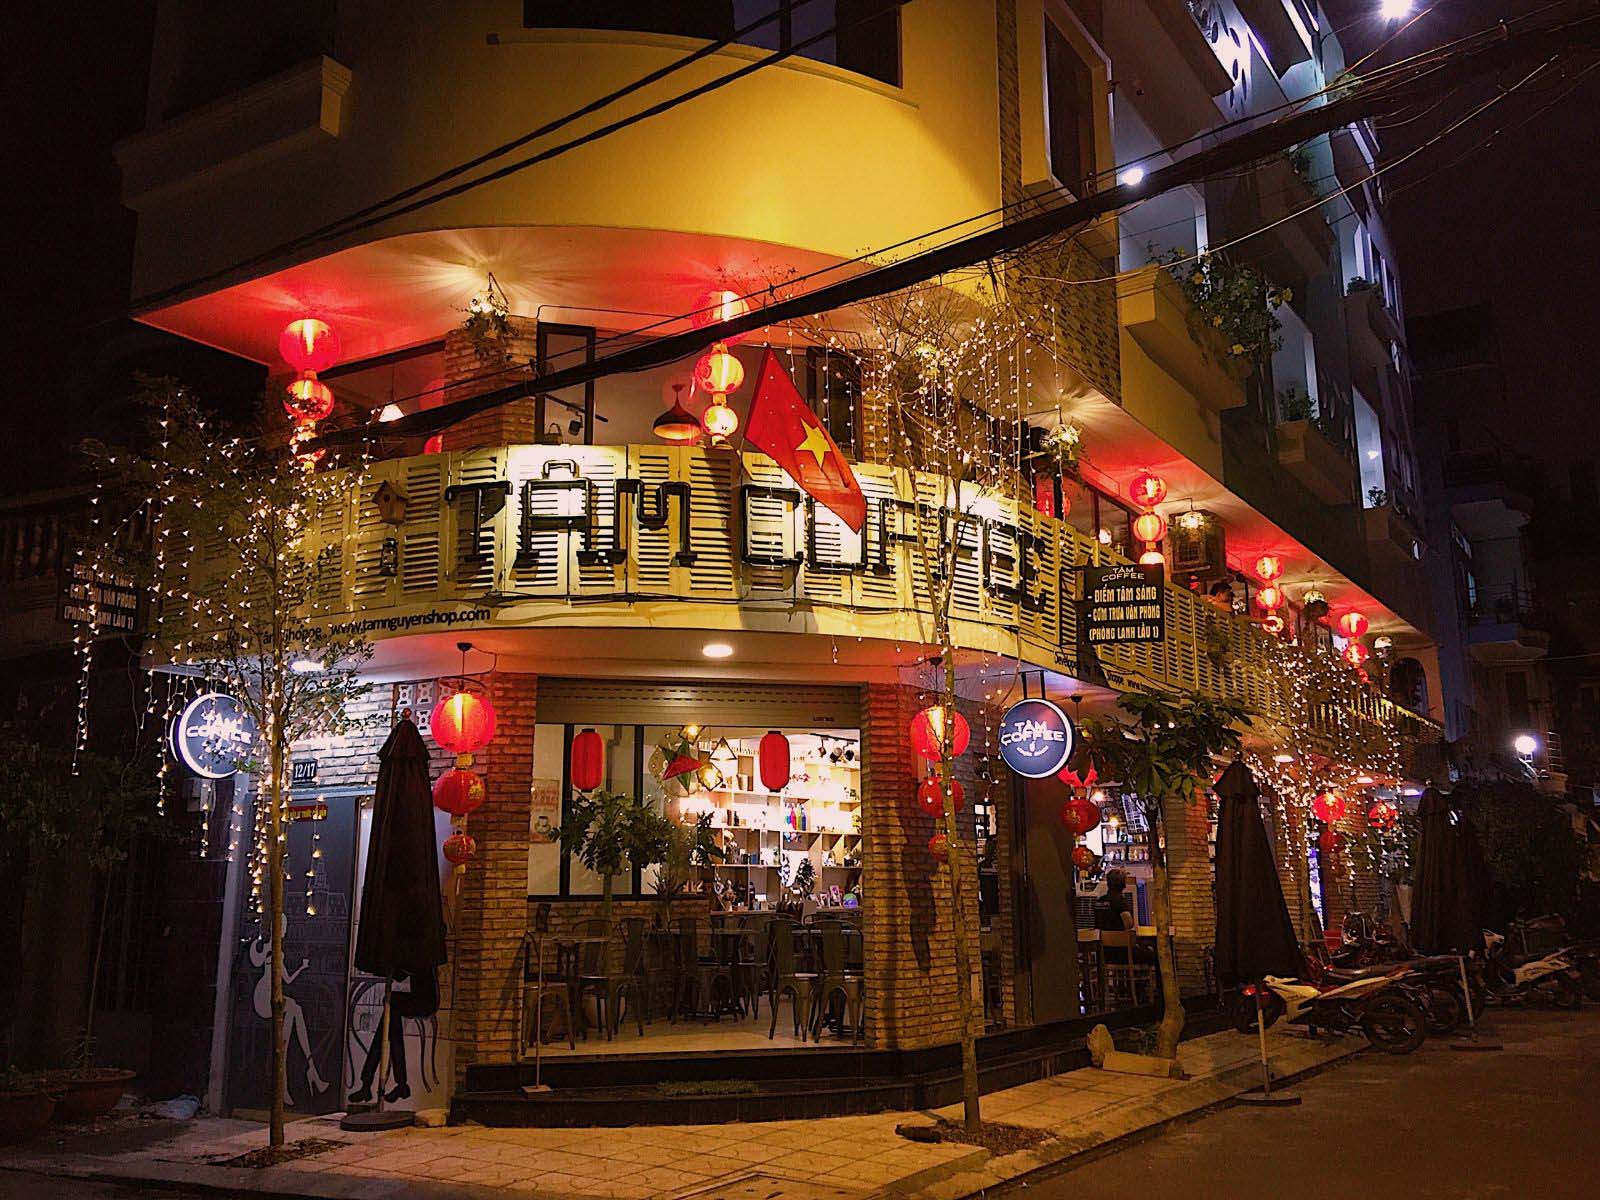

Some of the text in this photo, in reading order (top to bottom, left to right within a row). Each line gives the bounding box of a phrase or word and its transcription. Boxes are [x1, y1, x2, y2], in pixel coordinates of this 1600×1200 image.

[740, 483, 1047, 614] COFFEE
[1101, 572, 1145, 582] COFFEE
[1116, 585, 1134, 602] TÂM
[1136, 584, 1157, 601] SÁNG
[331, 608, 491, 635] www.tamnguyenshop.com
[1001, 729, 1065, 746] COFFEE
[294, 762, 316, 779] 12/17
